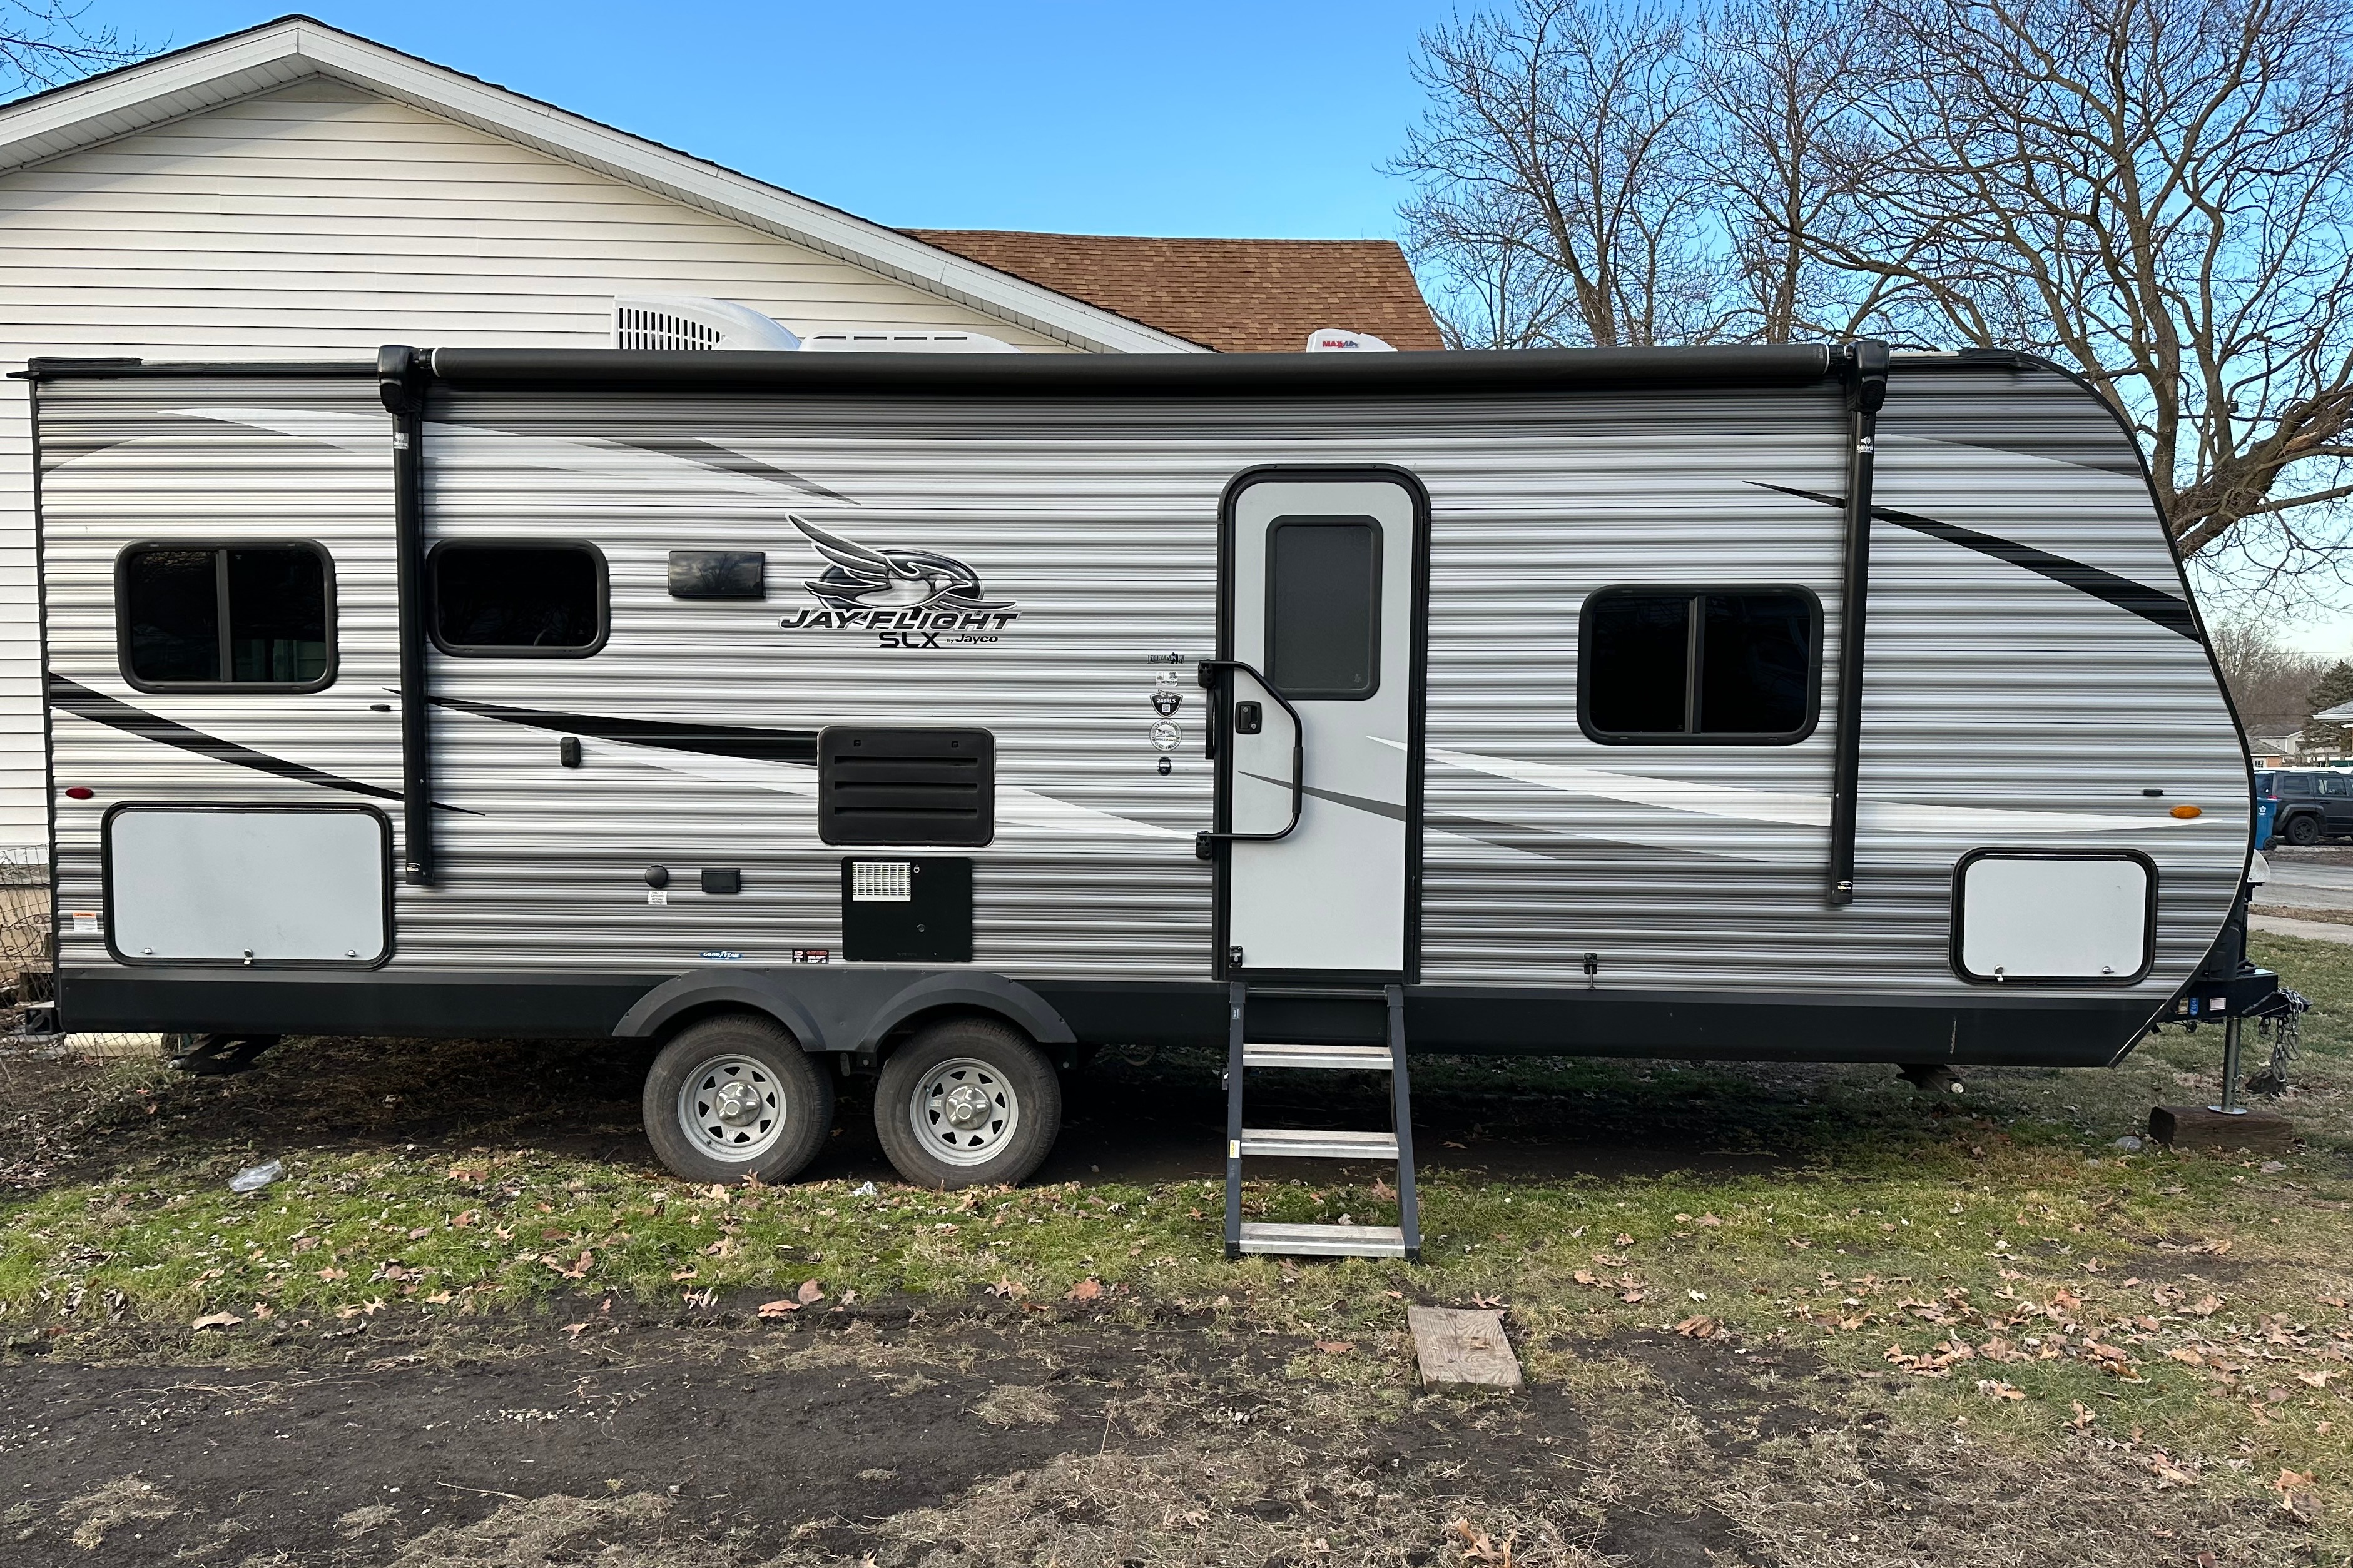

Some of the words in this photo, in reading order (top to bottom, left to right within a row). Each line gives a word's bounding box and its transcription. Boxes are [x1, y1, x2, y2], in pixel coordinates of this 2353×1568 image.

[780, 609, 864, 629] JAY
[864, 610, 1019, 631] FLIGHT
[878, 631, 941, 648] SLX
[955, 634, 999, 645] Jayco
